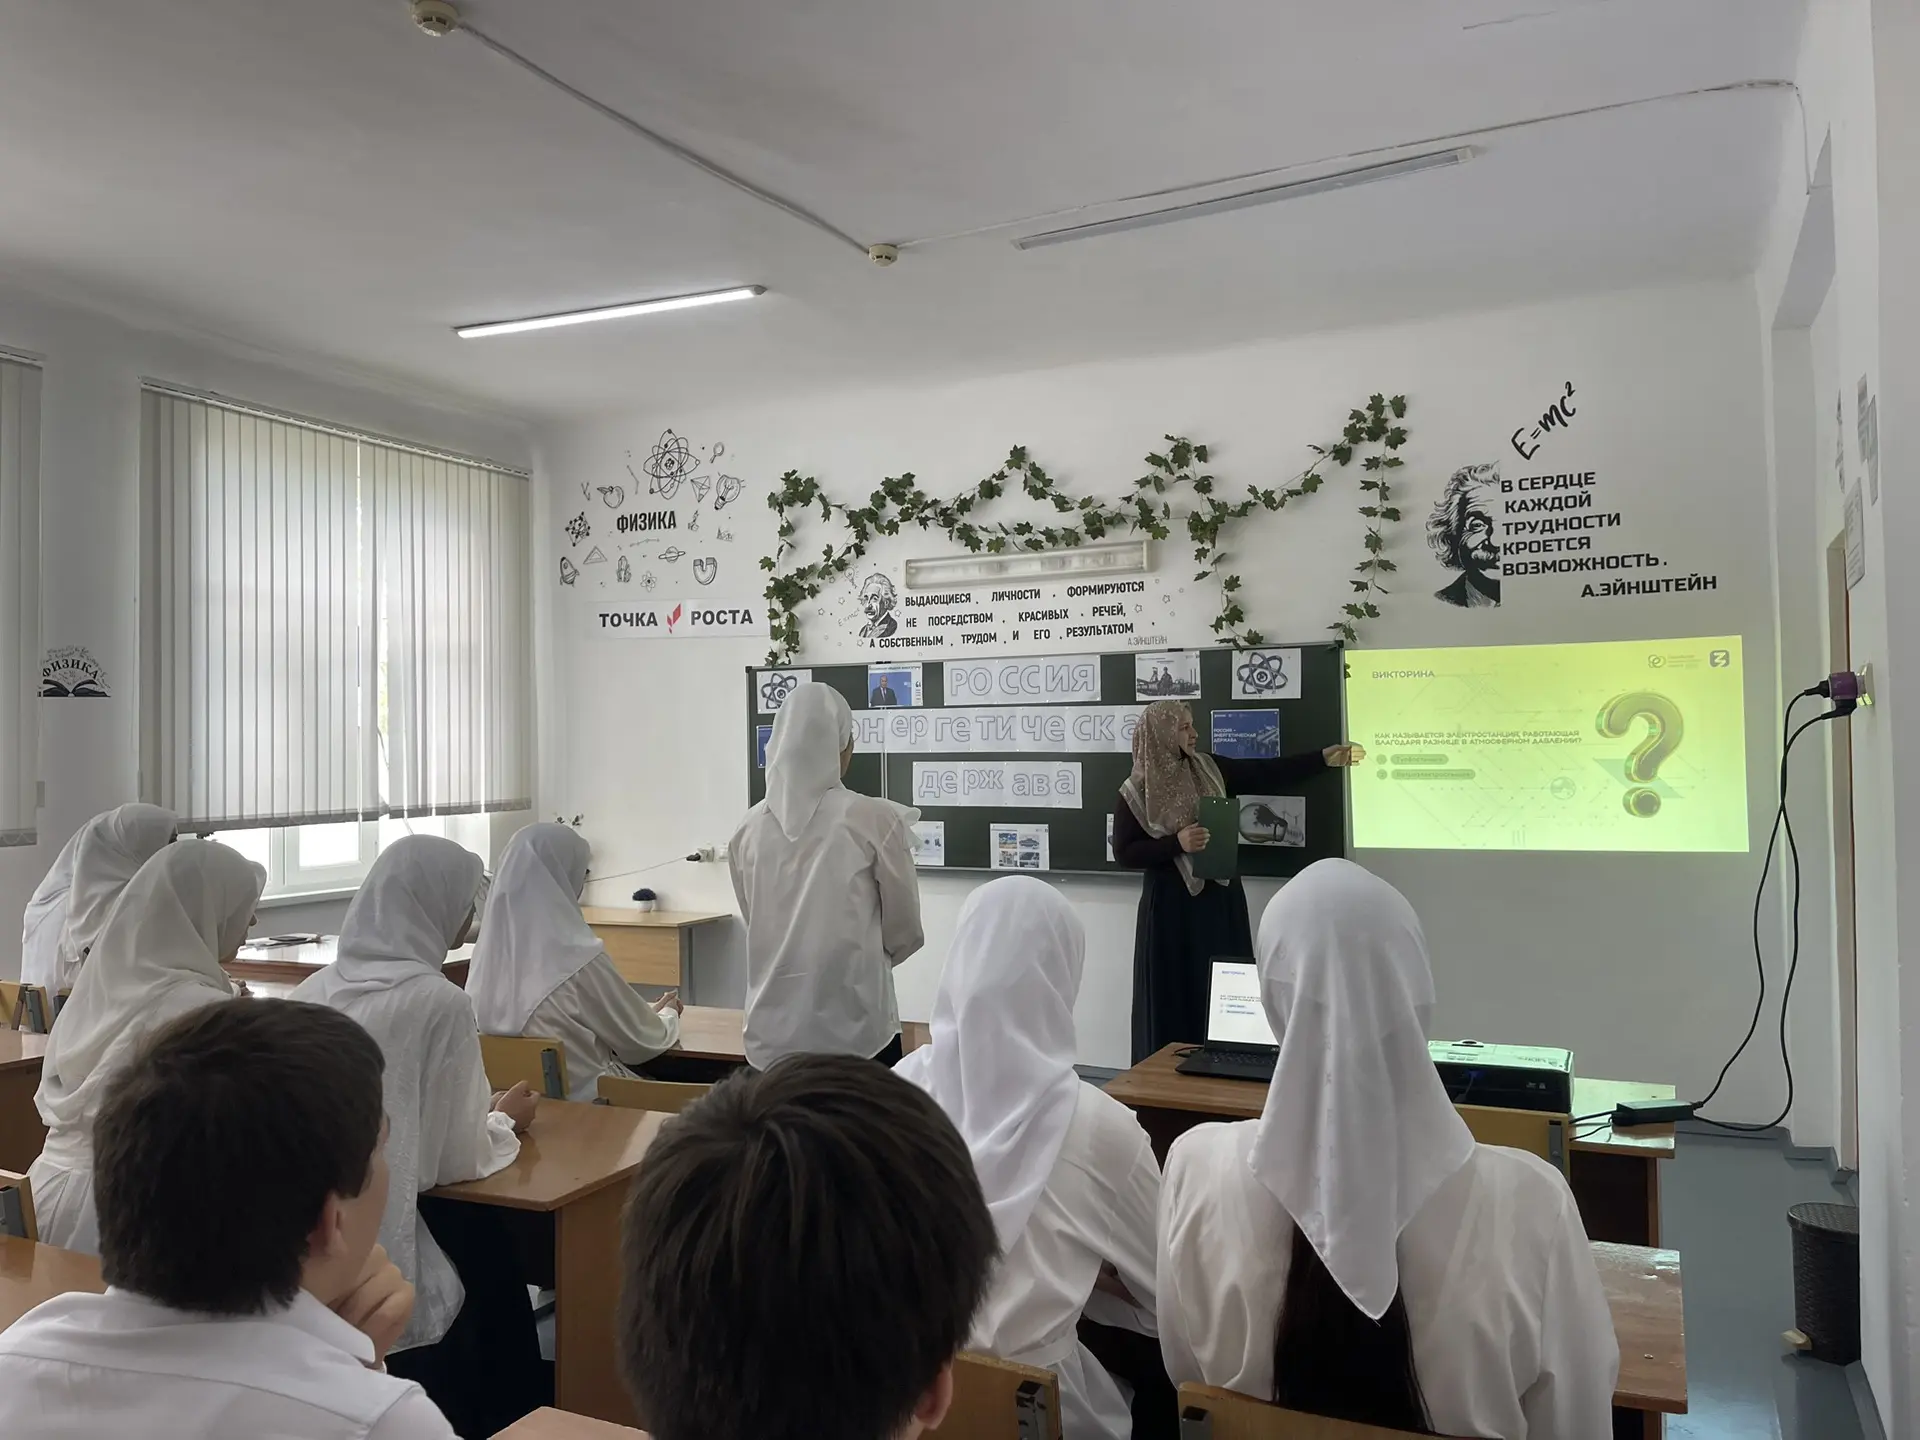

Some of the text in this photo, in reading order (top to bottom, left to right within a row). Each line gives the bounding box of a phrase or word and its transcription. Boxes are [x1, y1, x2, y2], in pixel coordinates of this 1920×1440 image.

[1500, 472, 1596, 493] В СЕРДЦЕ
[1504, 491, 1592, 514] КАЖДОЙ
[616, 510, 677, 533] ФИЗИКА
[1502, 512, 1621, 536] ТРУДНОСТИ
[1503, 536, 1591, 556] КРОЕТСЯ
[905, 580, 1145, 607] ВЫДАЮЩИЕСЯ ЛИЧНОСТИ ФОРМИРУЮТСЯ
[1580, 573, 1718, 598] А.ЭЙНШТЕЙН
[598, 609, 754, 628] ТОЧКА РОСТА
[906, 602, 1126, 628] НЕ ПОСРЕДСТВОМ КРАСИВЫХ РЕЧЕЙ,
[869, 623, 1134, 649] А СОБСТВЕННЫМ ТРУДОМ И ЕГО РЕЗУЛЬТАТОМ
[42, 658, 99, 680] ФИЗИКА
[950, 663, 1096, 697] РОССИЯ
[1371, 670, 1436, 679] ВИКТОРИНА
[1522, 730, 1580, 738] РАБОТАЮЩАЯ
[918, 767, 1077, 799] держава
